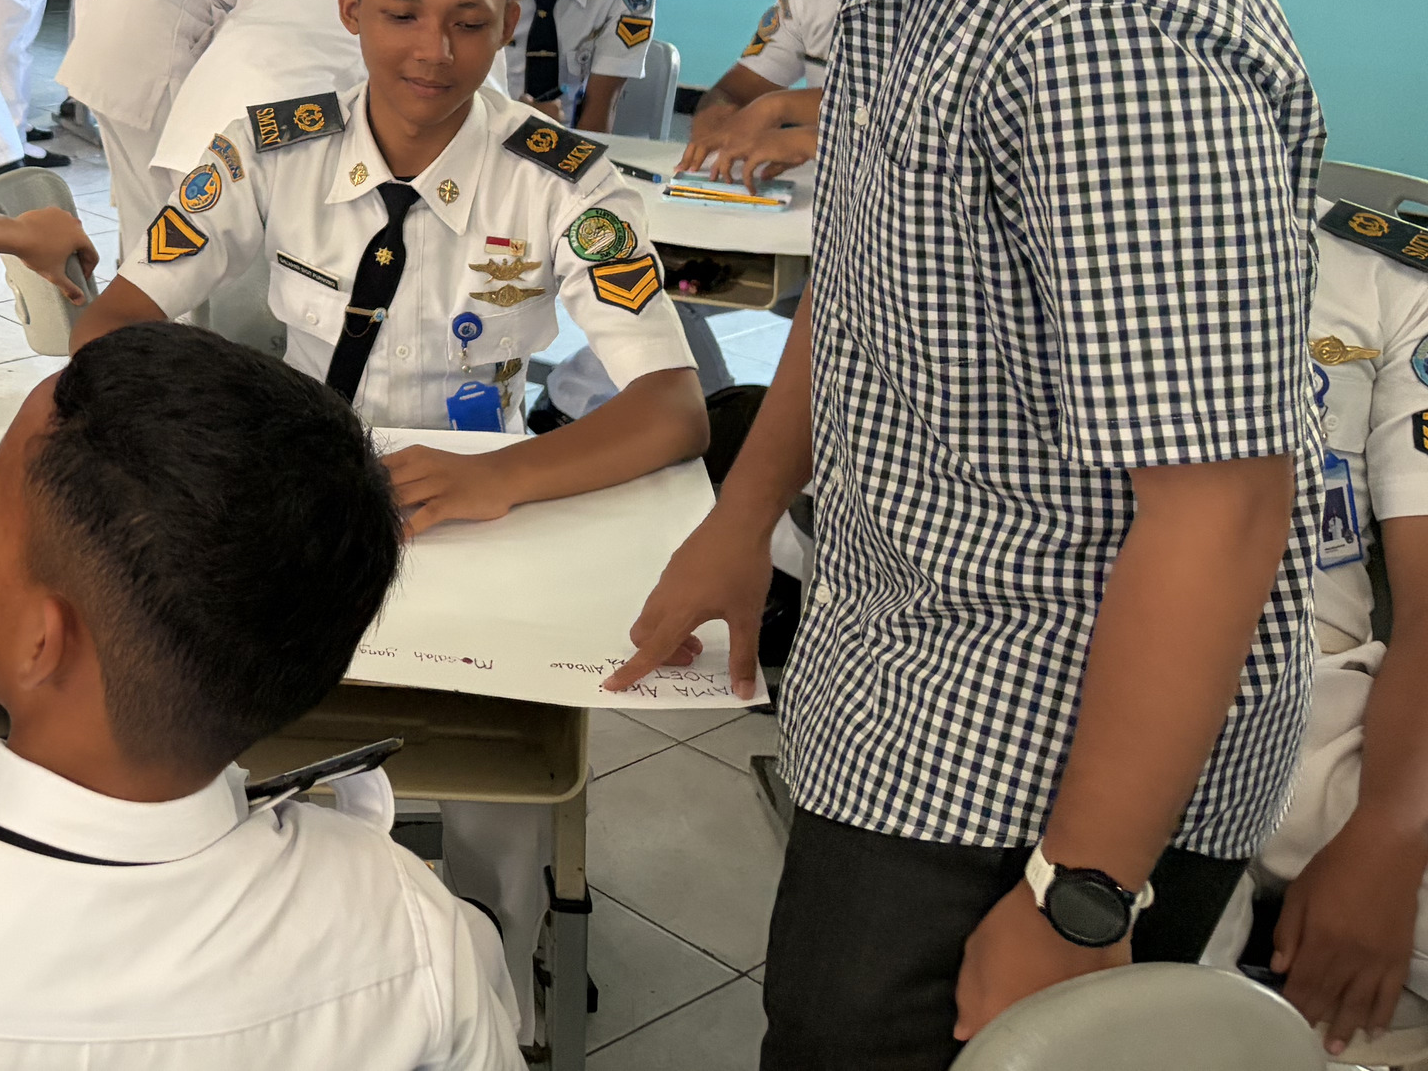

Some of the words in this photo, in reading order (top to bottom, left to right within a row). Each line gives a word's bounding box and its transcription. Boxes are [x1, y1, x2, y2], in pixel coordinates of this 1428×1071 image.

[256, 107, 281, 145] SMKN
[558, 140, 596, 174] SMKN
[673, 684, 735, 698] AMA
